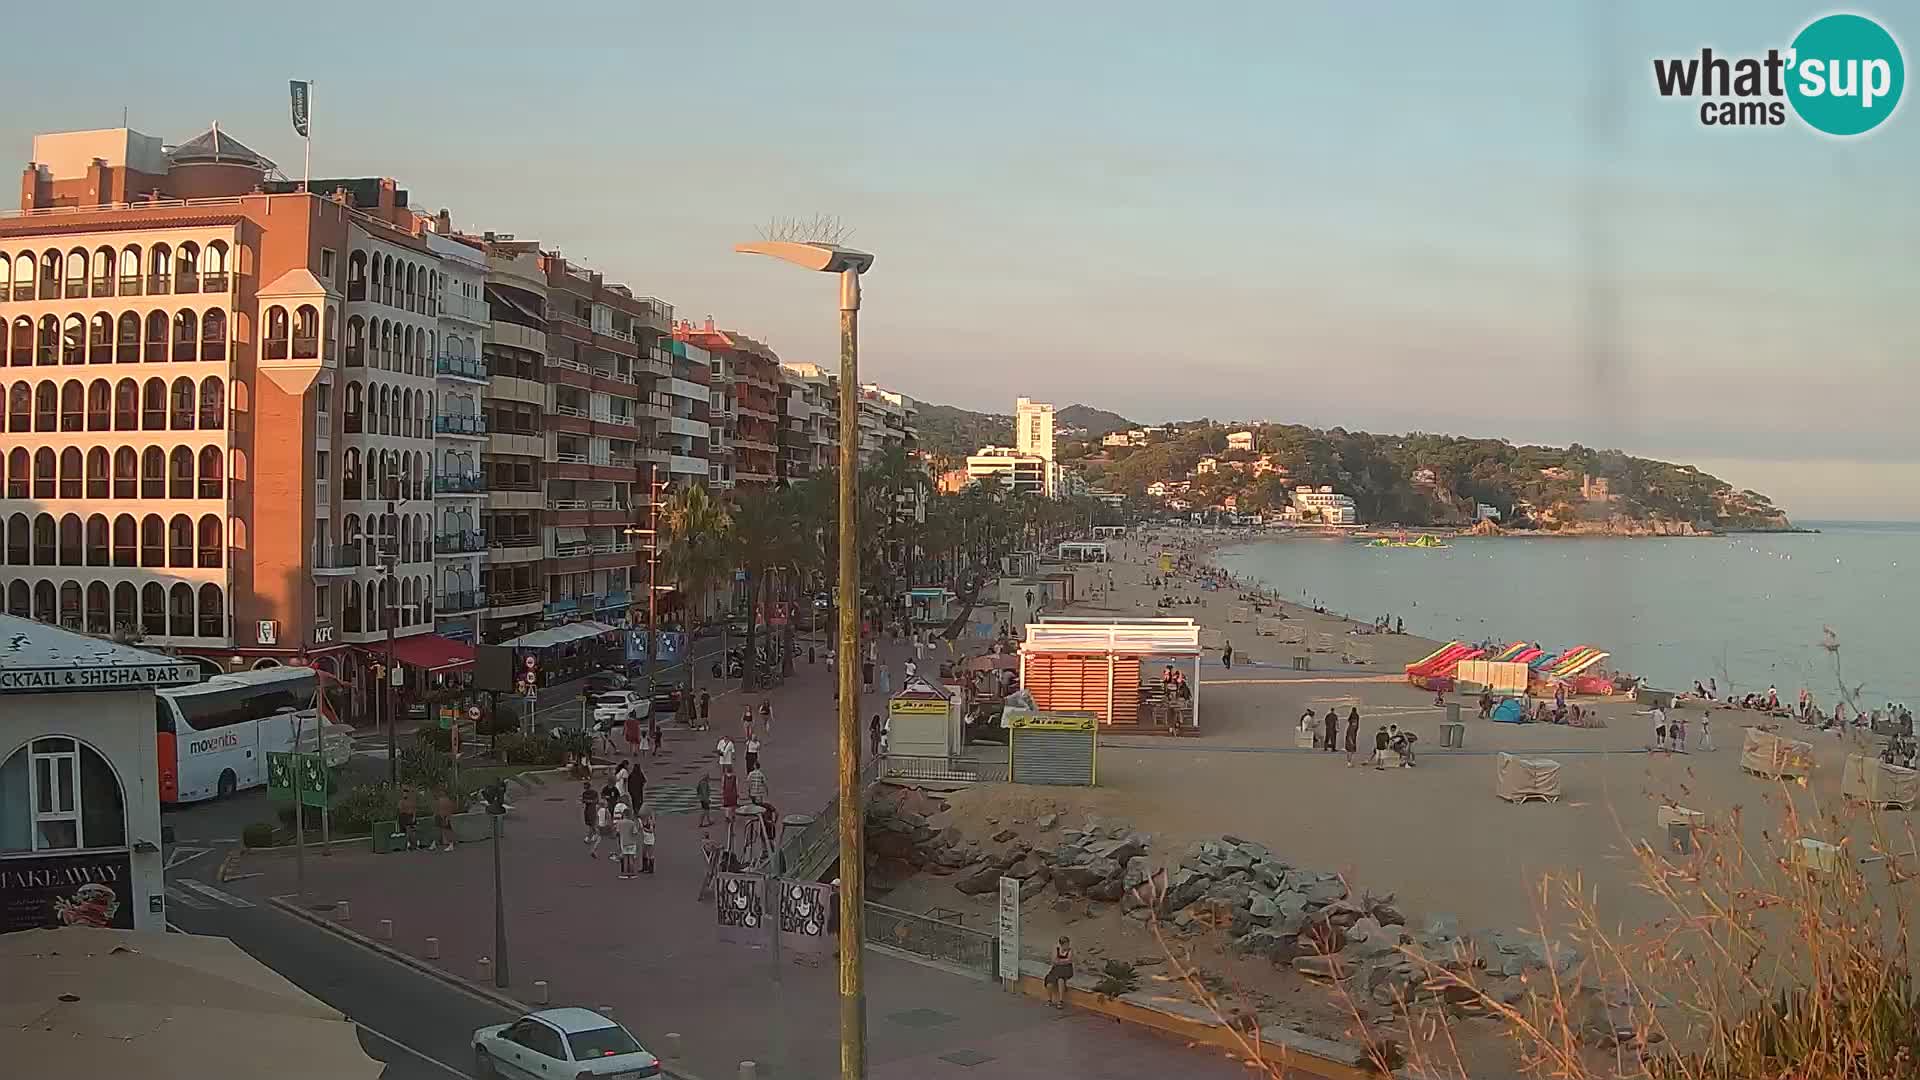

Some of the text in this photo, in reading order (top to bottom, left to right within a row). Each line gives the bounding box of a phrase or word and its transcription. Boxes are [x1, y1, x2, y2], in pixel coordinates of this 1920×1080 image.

[315, 626, 334, 644] KFC
[1, 667, 180, 687] CKTAIL & SHISHA BAR
[190, 729, 239, 755] moventis
